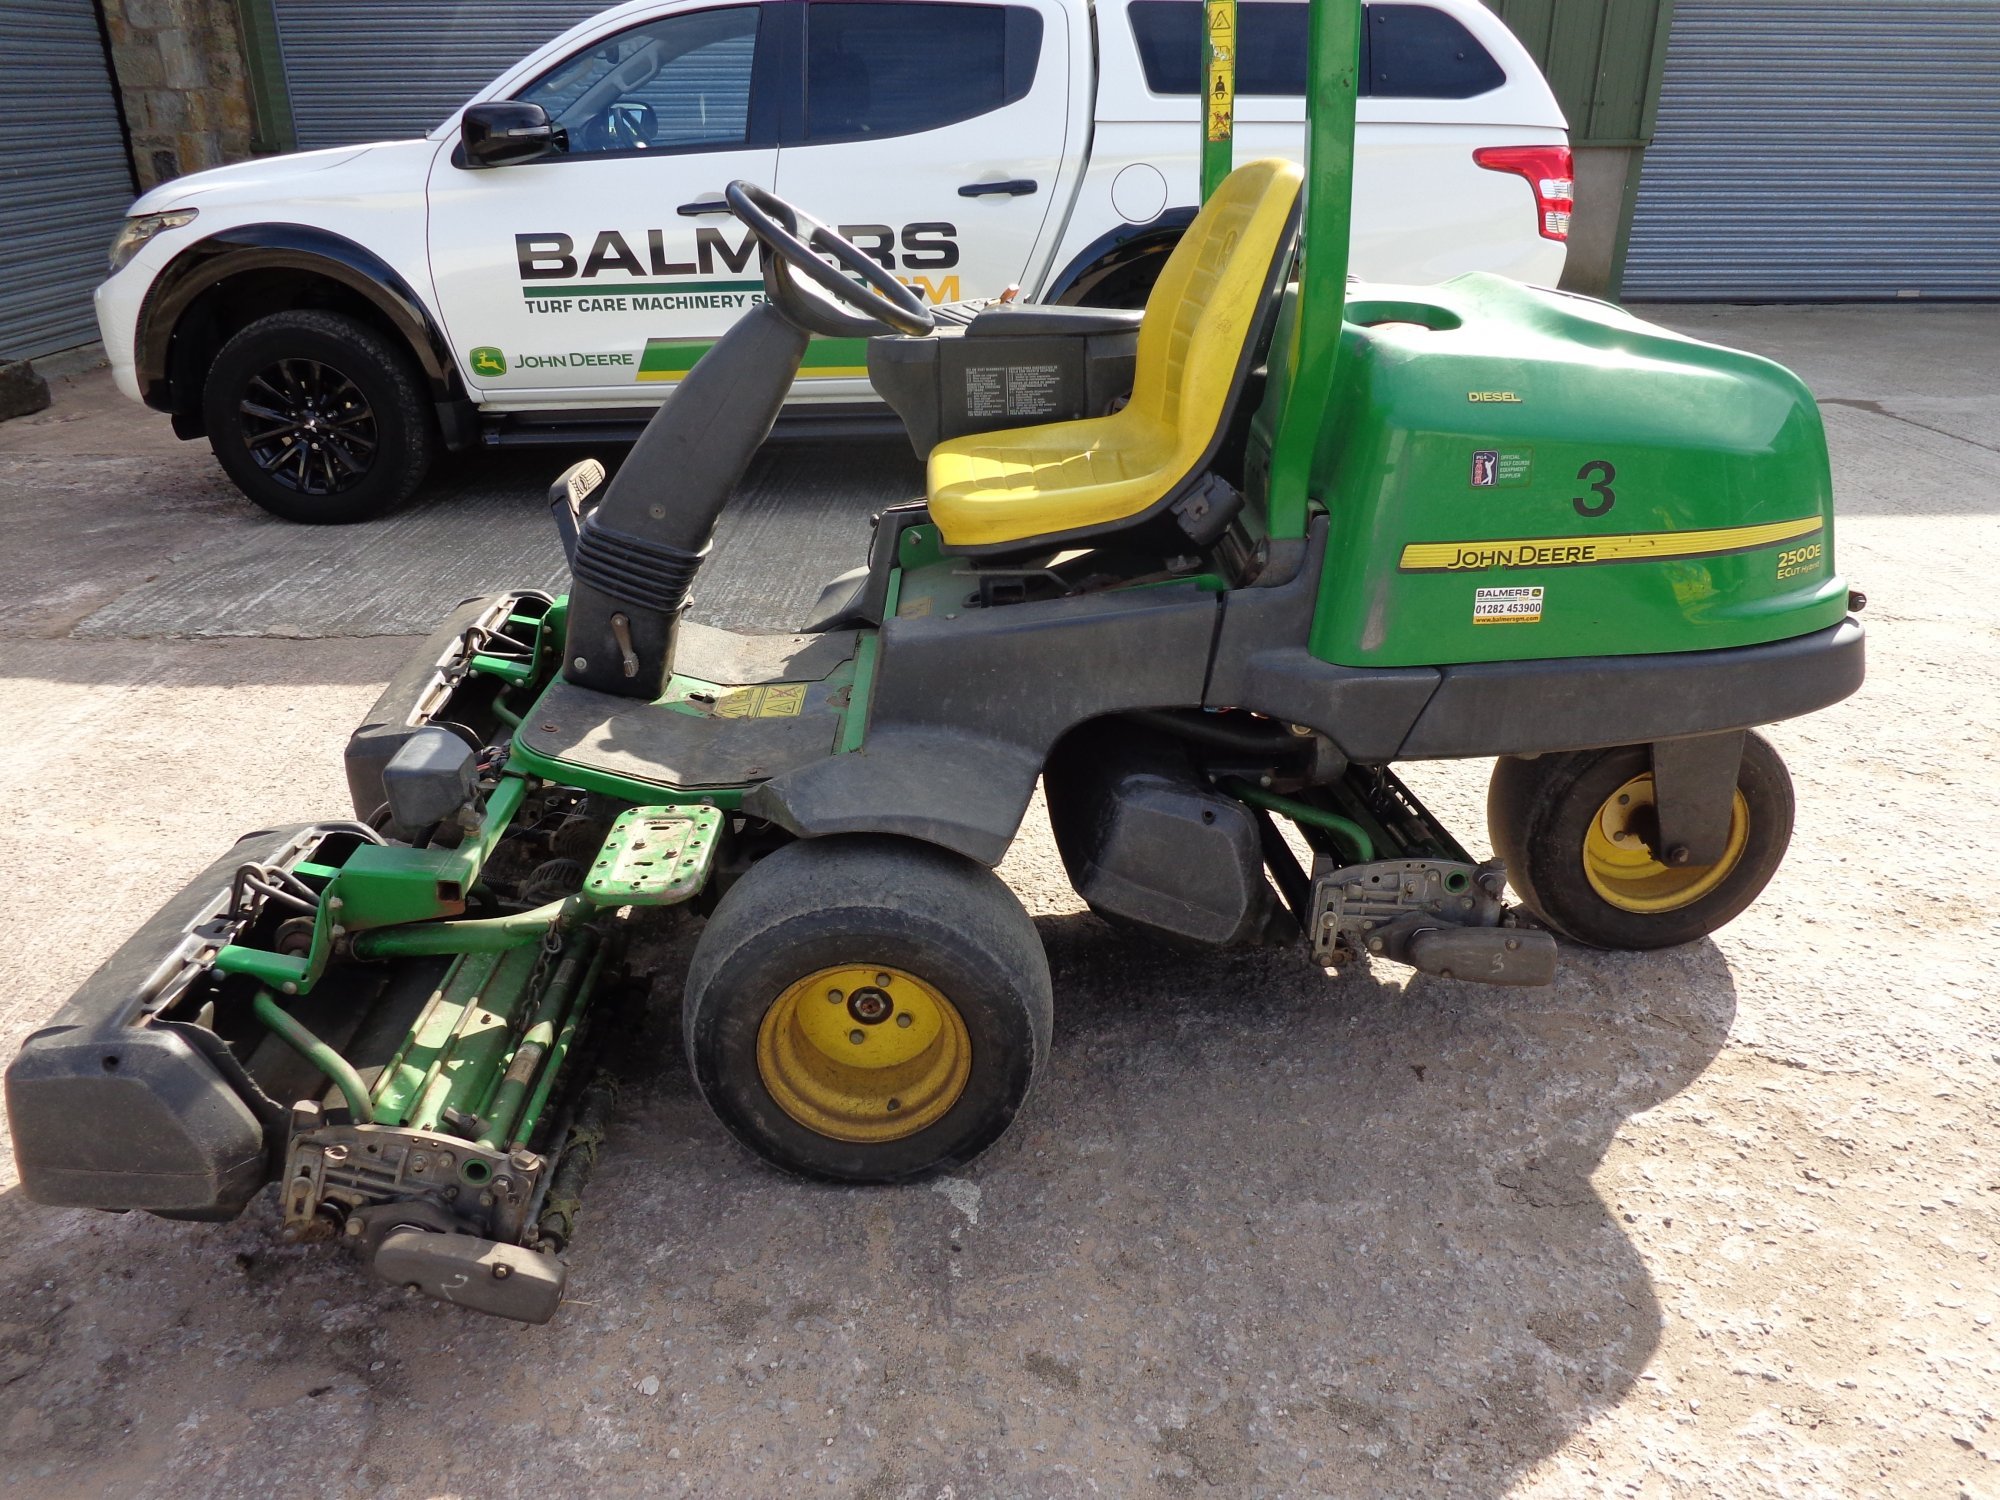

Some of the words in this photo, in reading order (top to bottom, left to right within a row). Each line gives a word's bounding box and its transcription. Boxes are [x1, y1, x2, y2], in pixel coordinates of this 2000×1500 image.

[515, 222, 959, 281] BALMRS
[525, 300, 572, 314] TURF
[578, 297, 628, 312] CARE
[632, 294, 745, 311] MACHINERY
[514, 354, 567, 369] JOHN
[569, 352, 634, 367] DEERE
[1468, 392, 1522, 402] DIESEL
[1572, 460, 1616, 518] 3
[1447, 549, 1513, 567] JOHN
[1518, 545, 1596, 563] DEERE
[1777, 543, 1822, 568] 2500E
[1477, 588, 1530, 598] BALMERS
[1475, 604, 1505, 614] 01282
[1506, 602, 1541, 613] 453900
[1475, 615, 1539, 623] www.balmersgm.com
